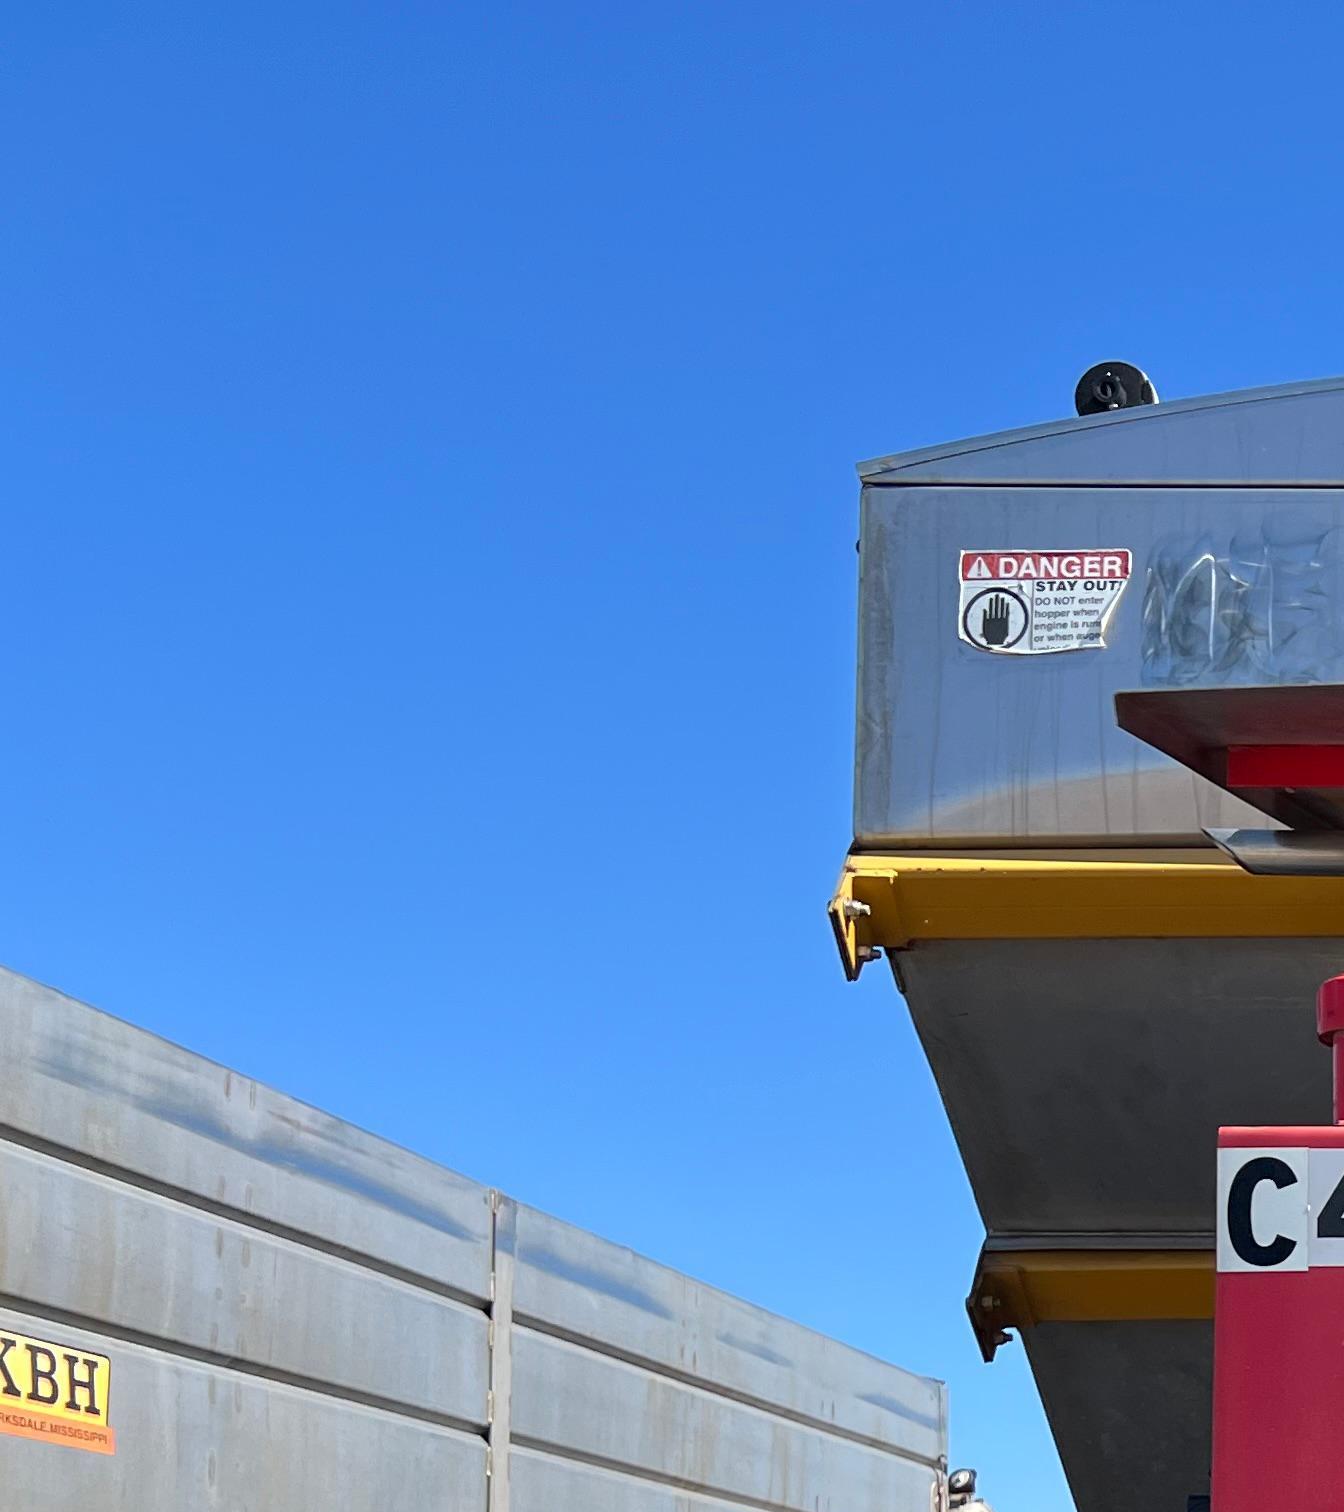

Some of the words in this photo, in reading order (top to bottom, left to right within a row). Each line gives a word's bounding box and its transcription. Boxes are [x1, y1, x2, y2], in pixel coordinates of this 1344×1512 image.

[999, 556, 1122, 578] DANGER
[1036, 580, 1077, 592] STAY
[1035, 597, 1051, 606] DO
[1054, 596, 1075, 605] NOT
[1078, 597, 1104, 605] enter
[1034, 609, 1070, 619] hopper
[1073, 608, 1099, 617] when
[1034, 622, 1068, 632] engine
[1071, 620, 1079, 628] is
[1034, 635, 1044, 643] or
[1047, 633, 1073, 642] when
